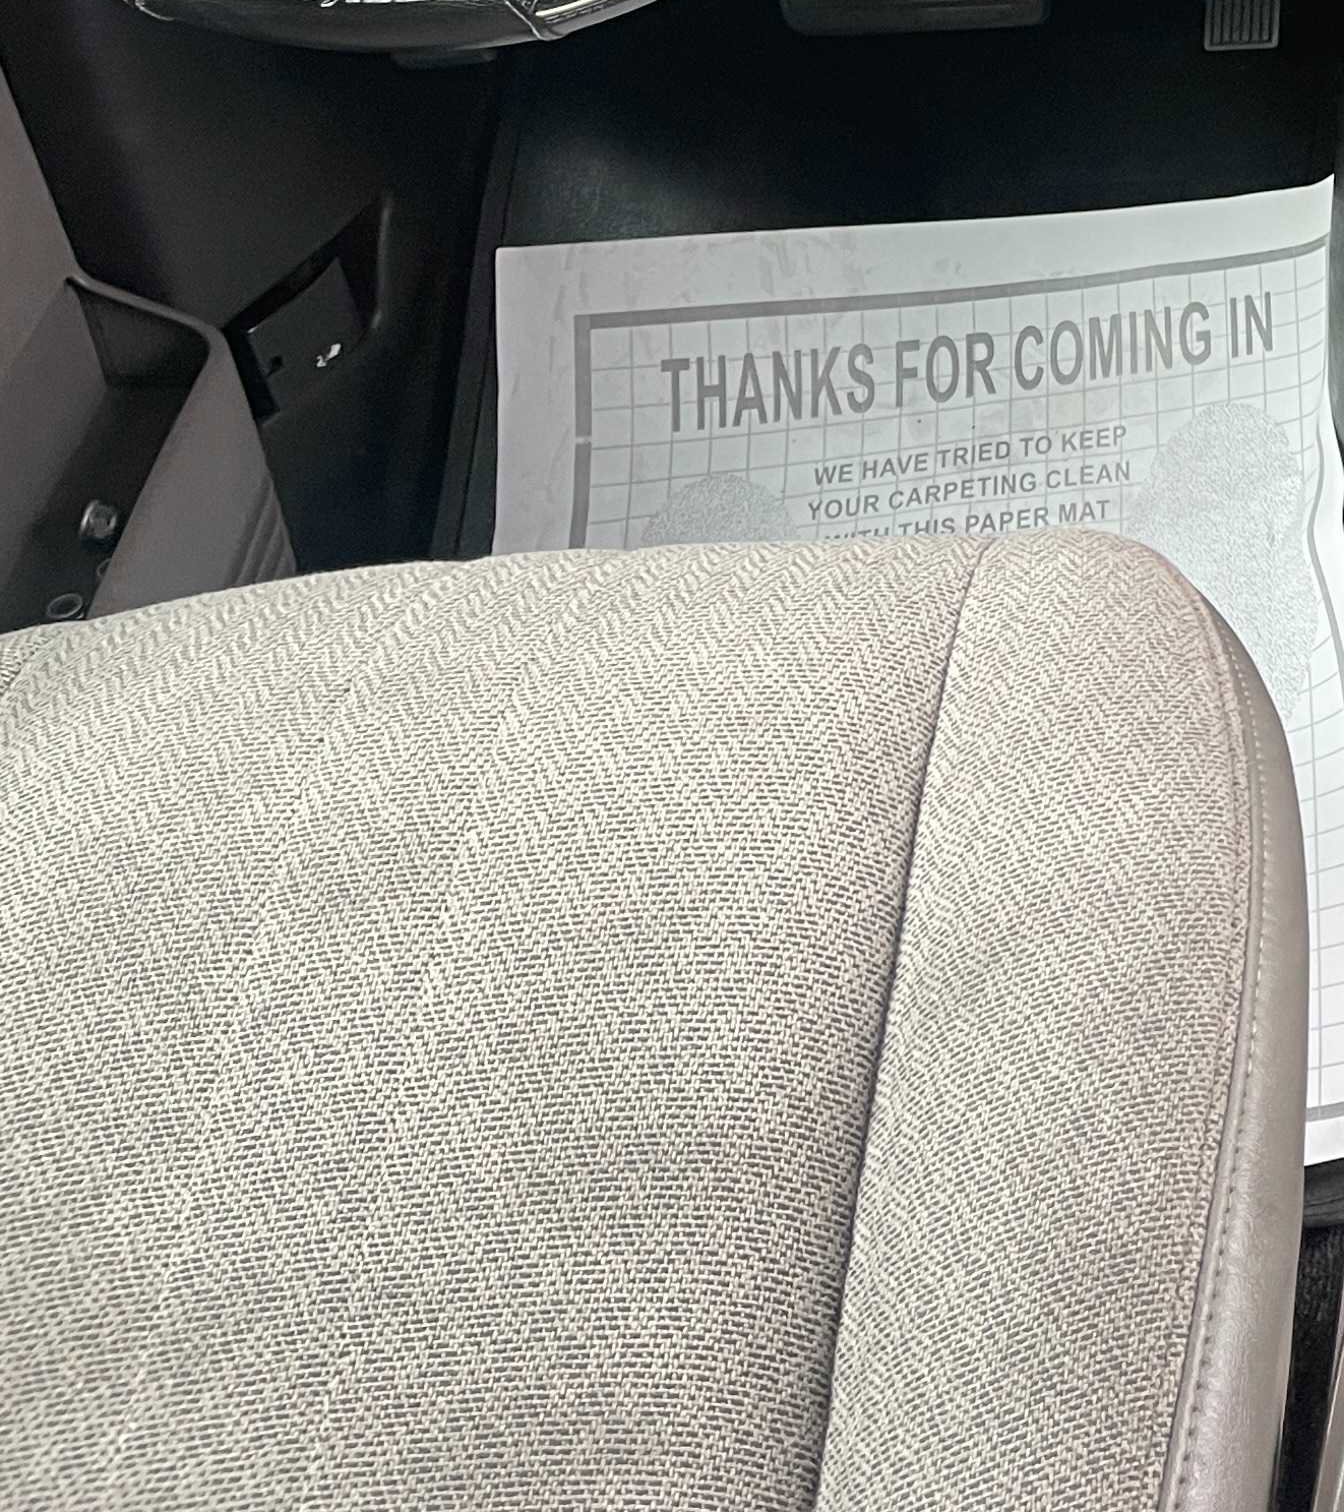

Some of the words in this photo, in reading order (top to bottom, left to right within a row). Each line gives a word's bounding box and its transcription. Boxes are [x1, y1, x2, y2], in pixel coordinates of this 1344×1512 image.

[660, 343, 876, 433] THANKS
[895, 331, 998, 408] FOR
[1013, 300, 1212, 390] COMING
[1228, 290, 1275, 359] IN
[814, 463, 853, 486] WE
[862, 452, 929, 480] HAVE
[936, 440, 1011, 469] TRIED
[1019, 436, 1053, 458] TO
[1061, 425, 1128, 452] KEEP
[807, 494, 879, 521] YOUR
[888, 472, 1037, 511] CARPETING
[1045, 461, 1131, 489] CLEAN
[898, 517, 956, 536] THIS
[965, 506, 1049, 535] PAPER
[1057, 499, 1111, 524] MAT
